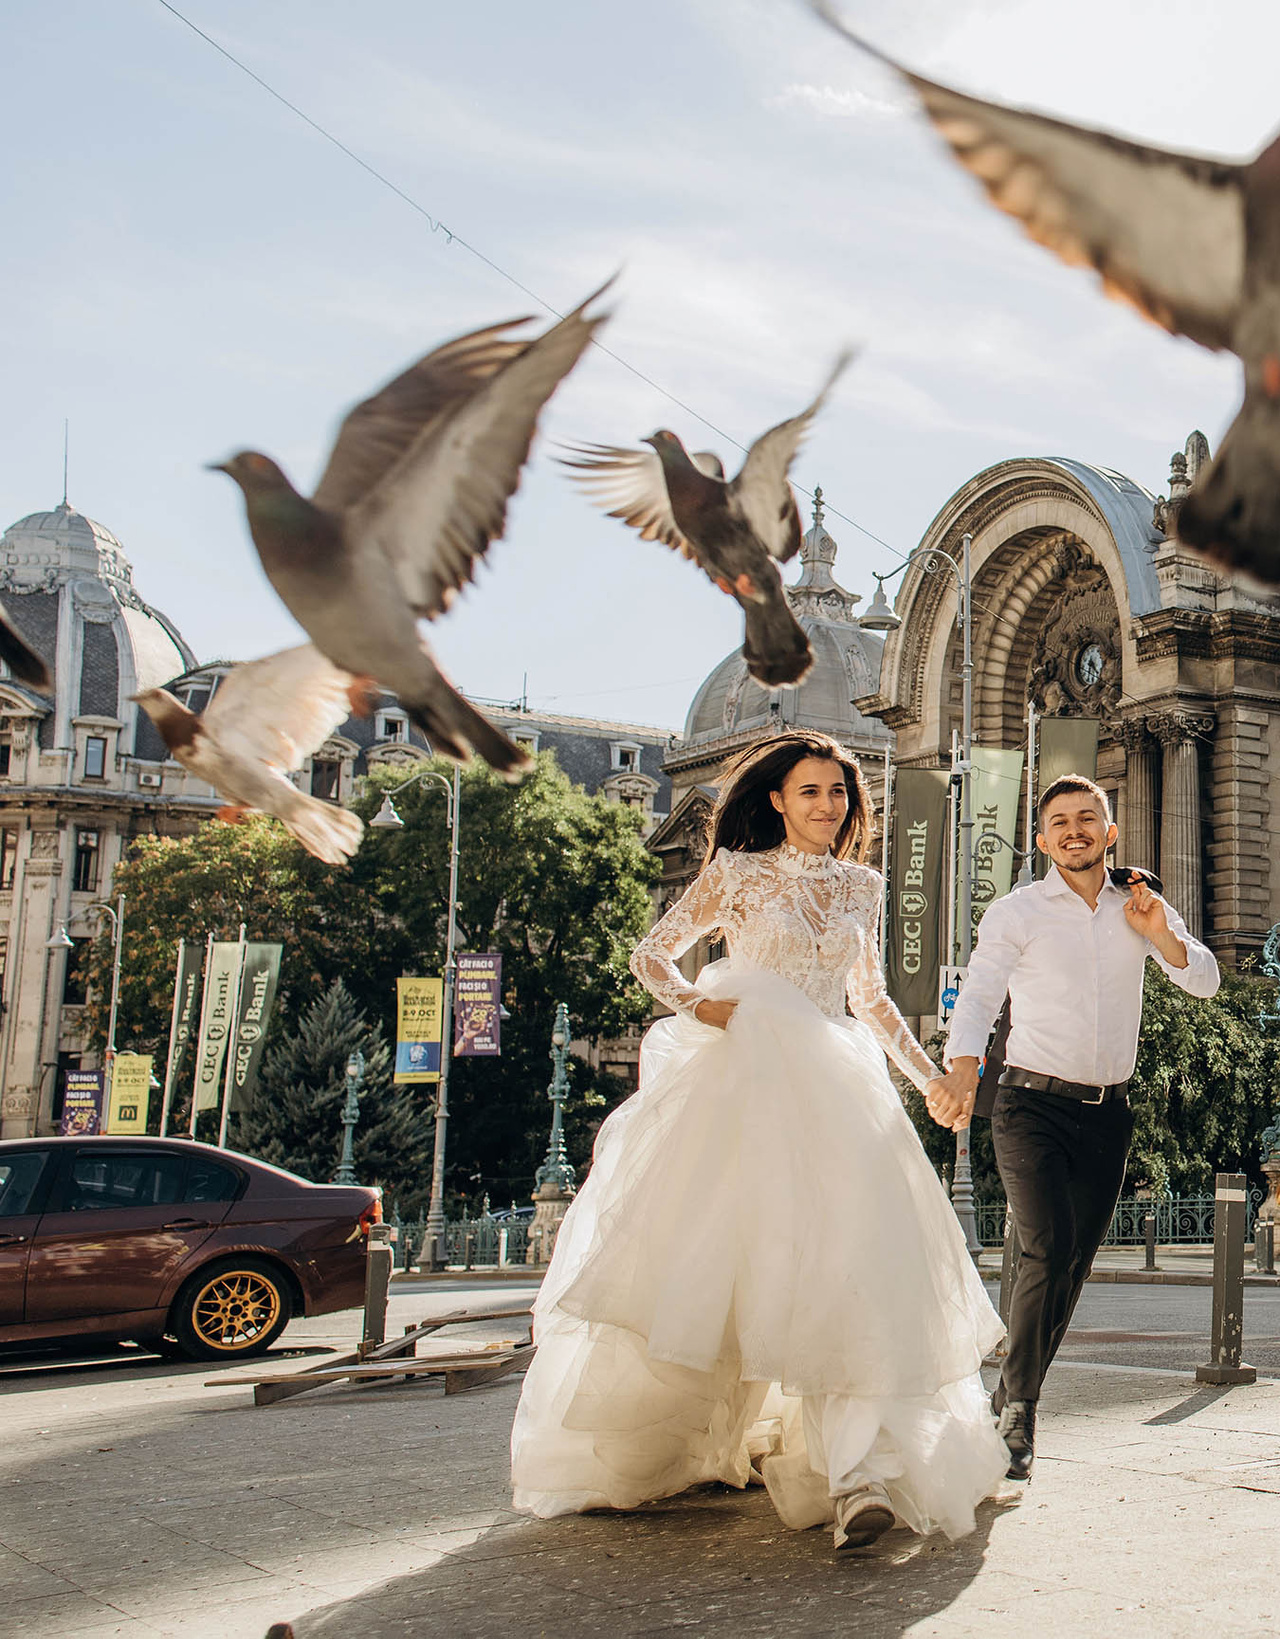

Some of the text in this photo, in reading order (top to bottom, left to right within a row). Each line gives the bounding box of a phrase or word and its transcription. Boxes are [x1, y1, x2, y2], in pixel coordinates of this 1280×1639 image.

[976, 804, 999, 873] Bank
[902, 819, 928, 975] CEC Bank
[181, 972, 196, 1022] Bank
[202, 971, 230, 1083] CEC Bank
[235, 968, 270, 1087] CEC Bank
